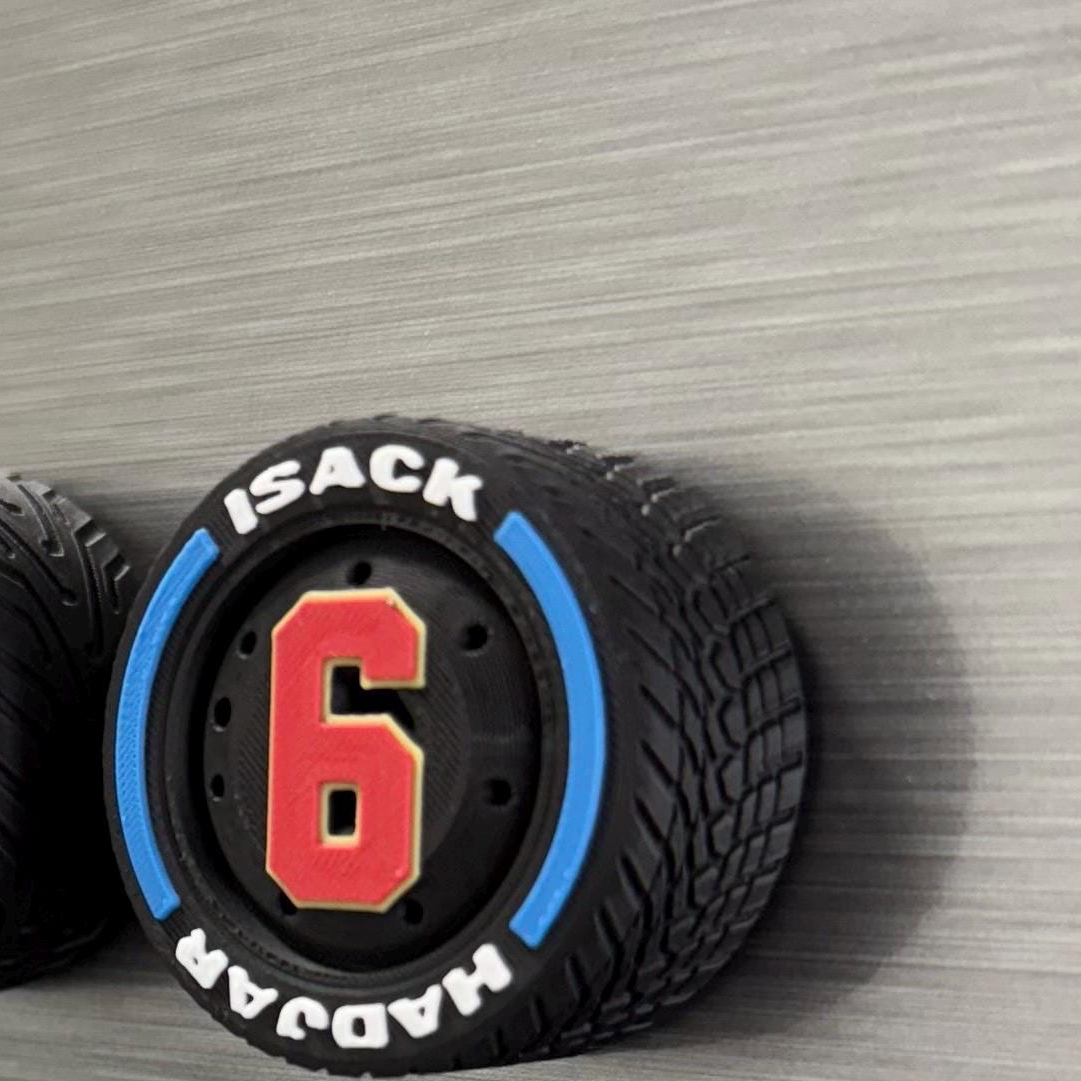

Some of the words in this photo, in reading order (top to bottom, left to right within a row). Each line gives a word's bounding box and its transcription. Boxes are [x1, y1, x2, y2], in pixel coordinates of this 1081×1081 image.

[223, 443, 483, 535] ISACK
[265, 588, 426, 913] 6
[175, 927, 512, 1049] HADJAR
